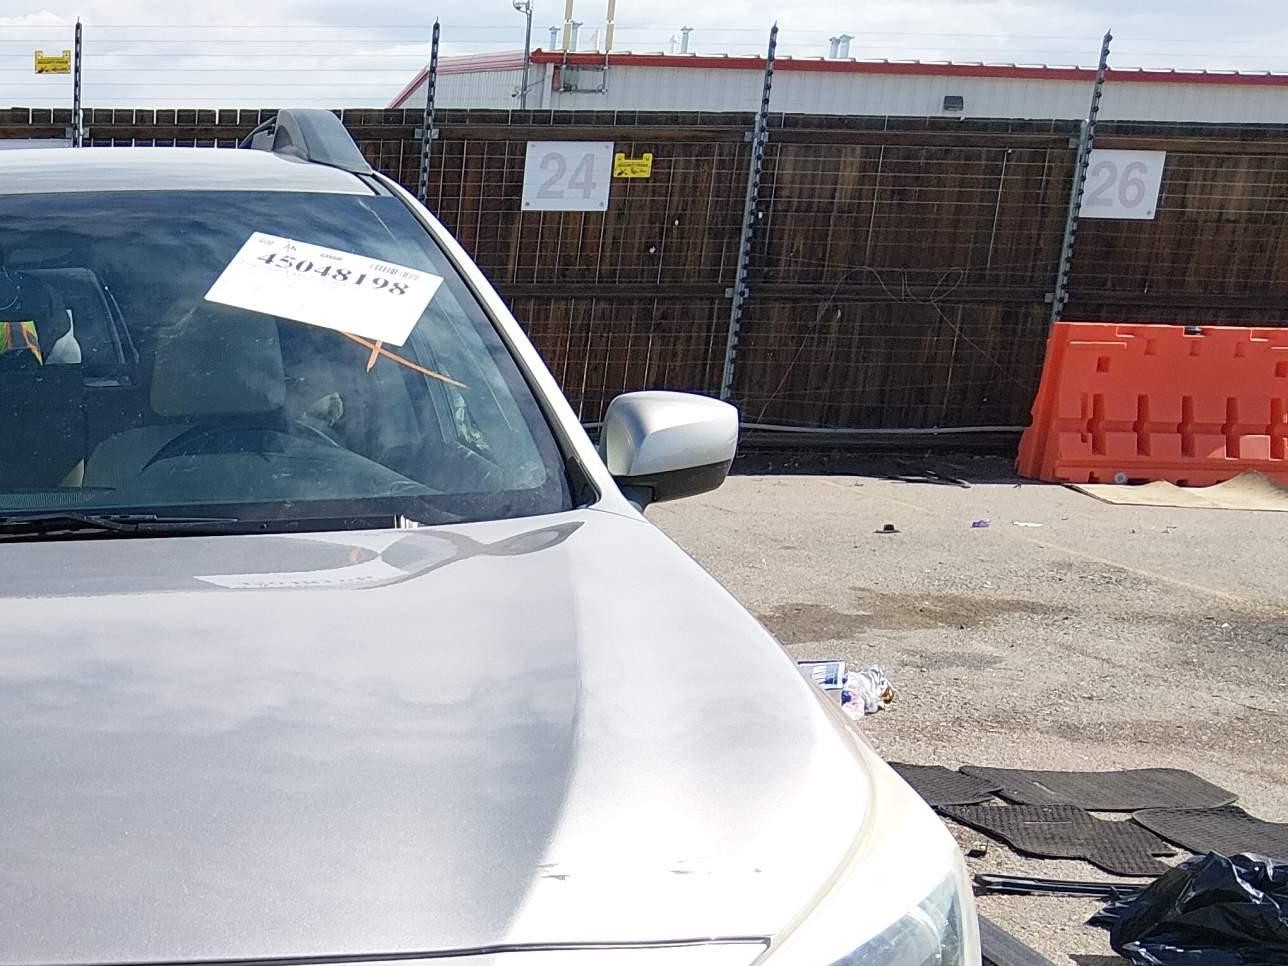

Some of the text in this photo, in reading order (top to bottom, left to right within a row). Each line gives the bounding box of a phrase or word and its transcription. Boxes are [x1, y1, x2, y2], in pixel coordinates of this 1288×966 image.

[536, 152, 597, 199] 24
[1085, 161, 1148, 208] 26
[256, 253, 409, 296] 45048198
